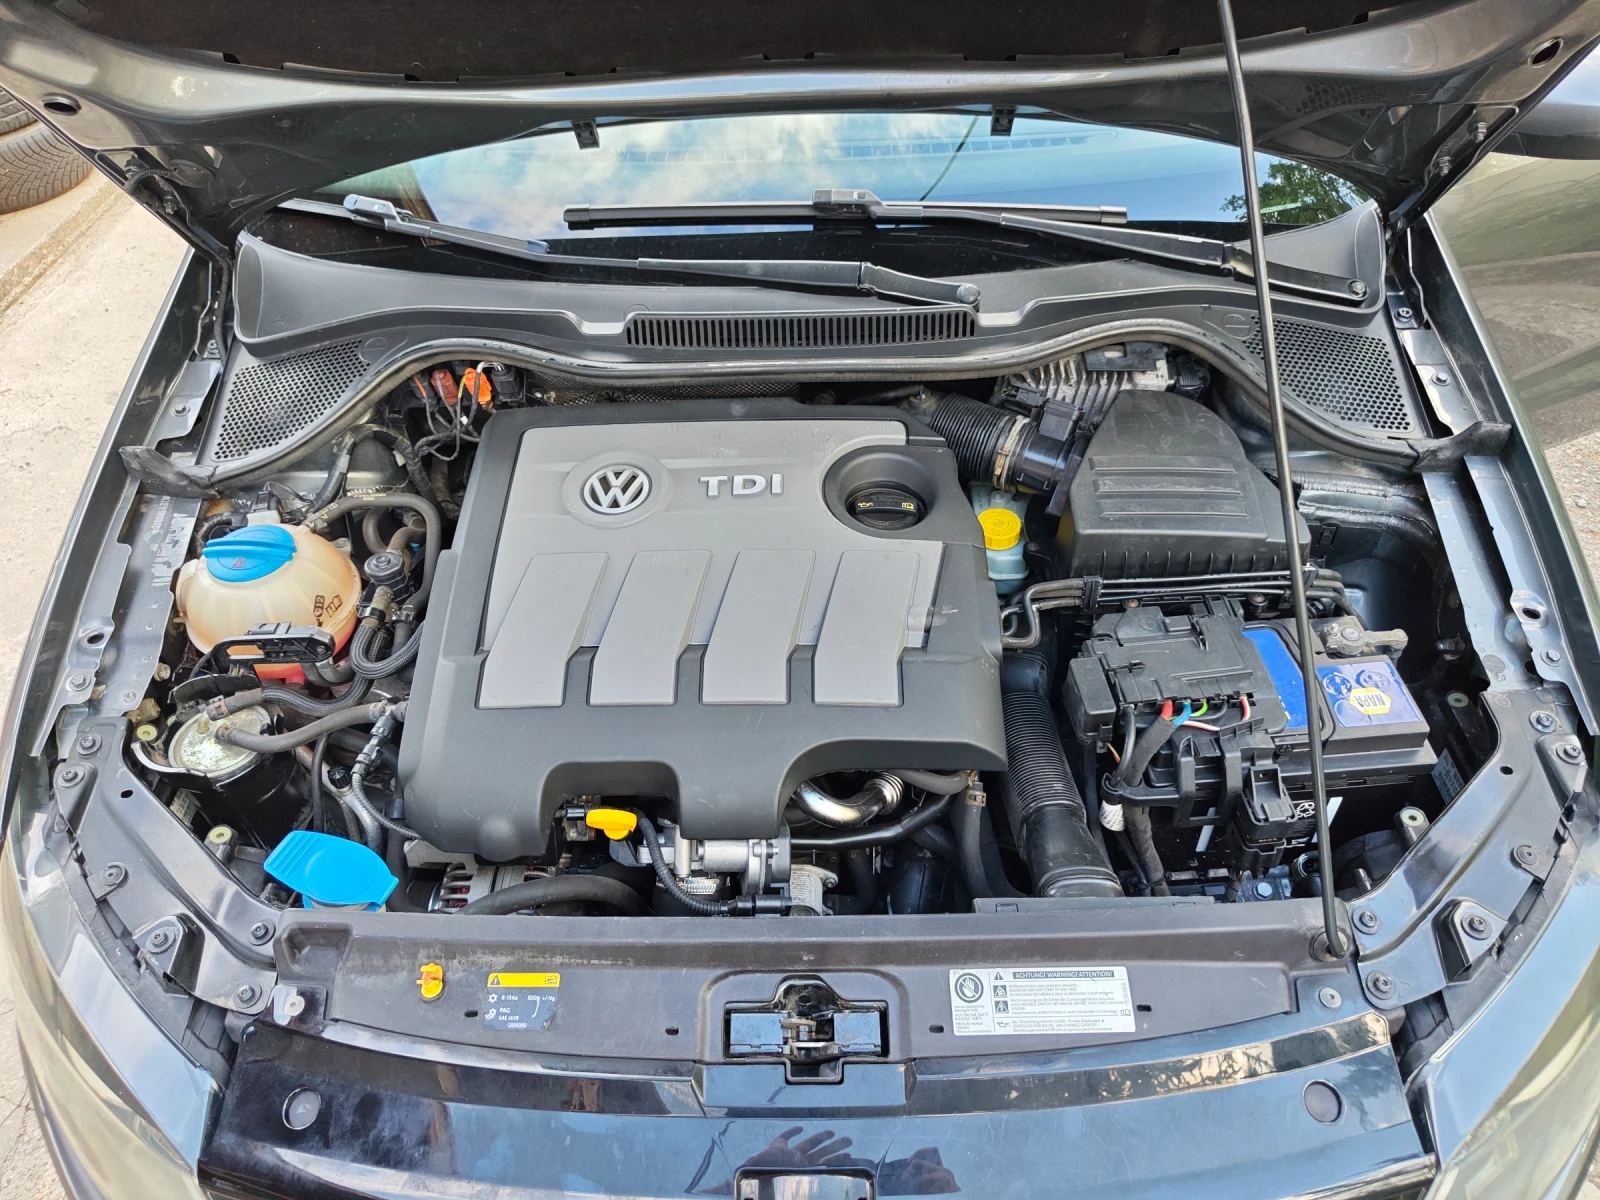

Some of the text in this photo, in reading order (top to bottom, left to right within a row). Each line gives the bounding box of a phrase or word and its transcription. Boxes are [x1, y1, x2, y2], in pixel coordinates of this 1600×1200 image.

[584, 467, 649, 514] VW
[700, 473, 784, 499] TDI
[1354, 693, 1387, 708] NAPA
[1078, 970, 1113, 978] ATTENTION!
